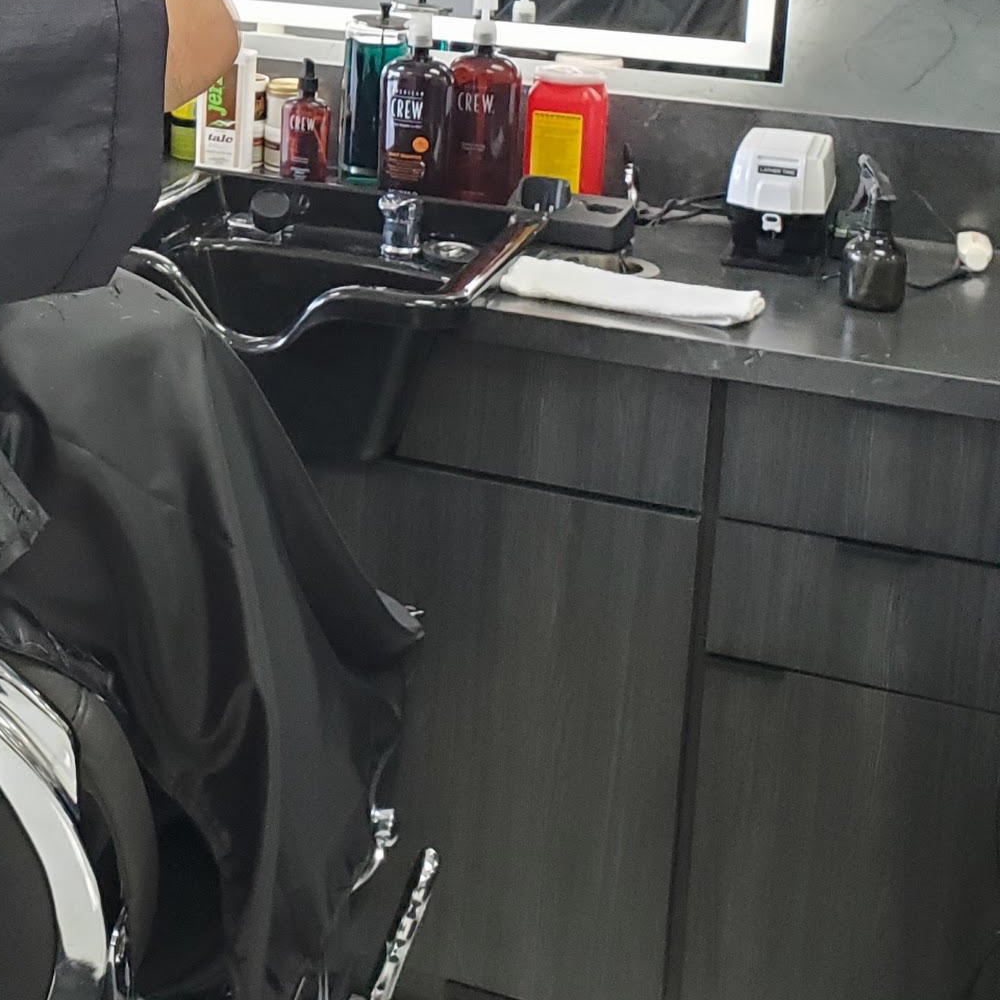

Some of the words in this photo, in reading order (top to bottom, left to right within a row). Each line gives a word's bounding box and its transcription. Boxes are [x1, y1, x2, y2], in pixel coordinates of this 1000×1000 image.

[391, 97, 424, 120] CREW
[290, 115, 315, 132] CREW
[208, 133, 233, 143] talc
